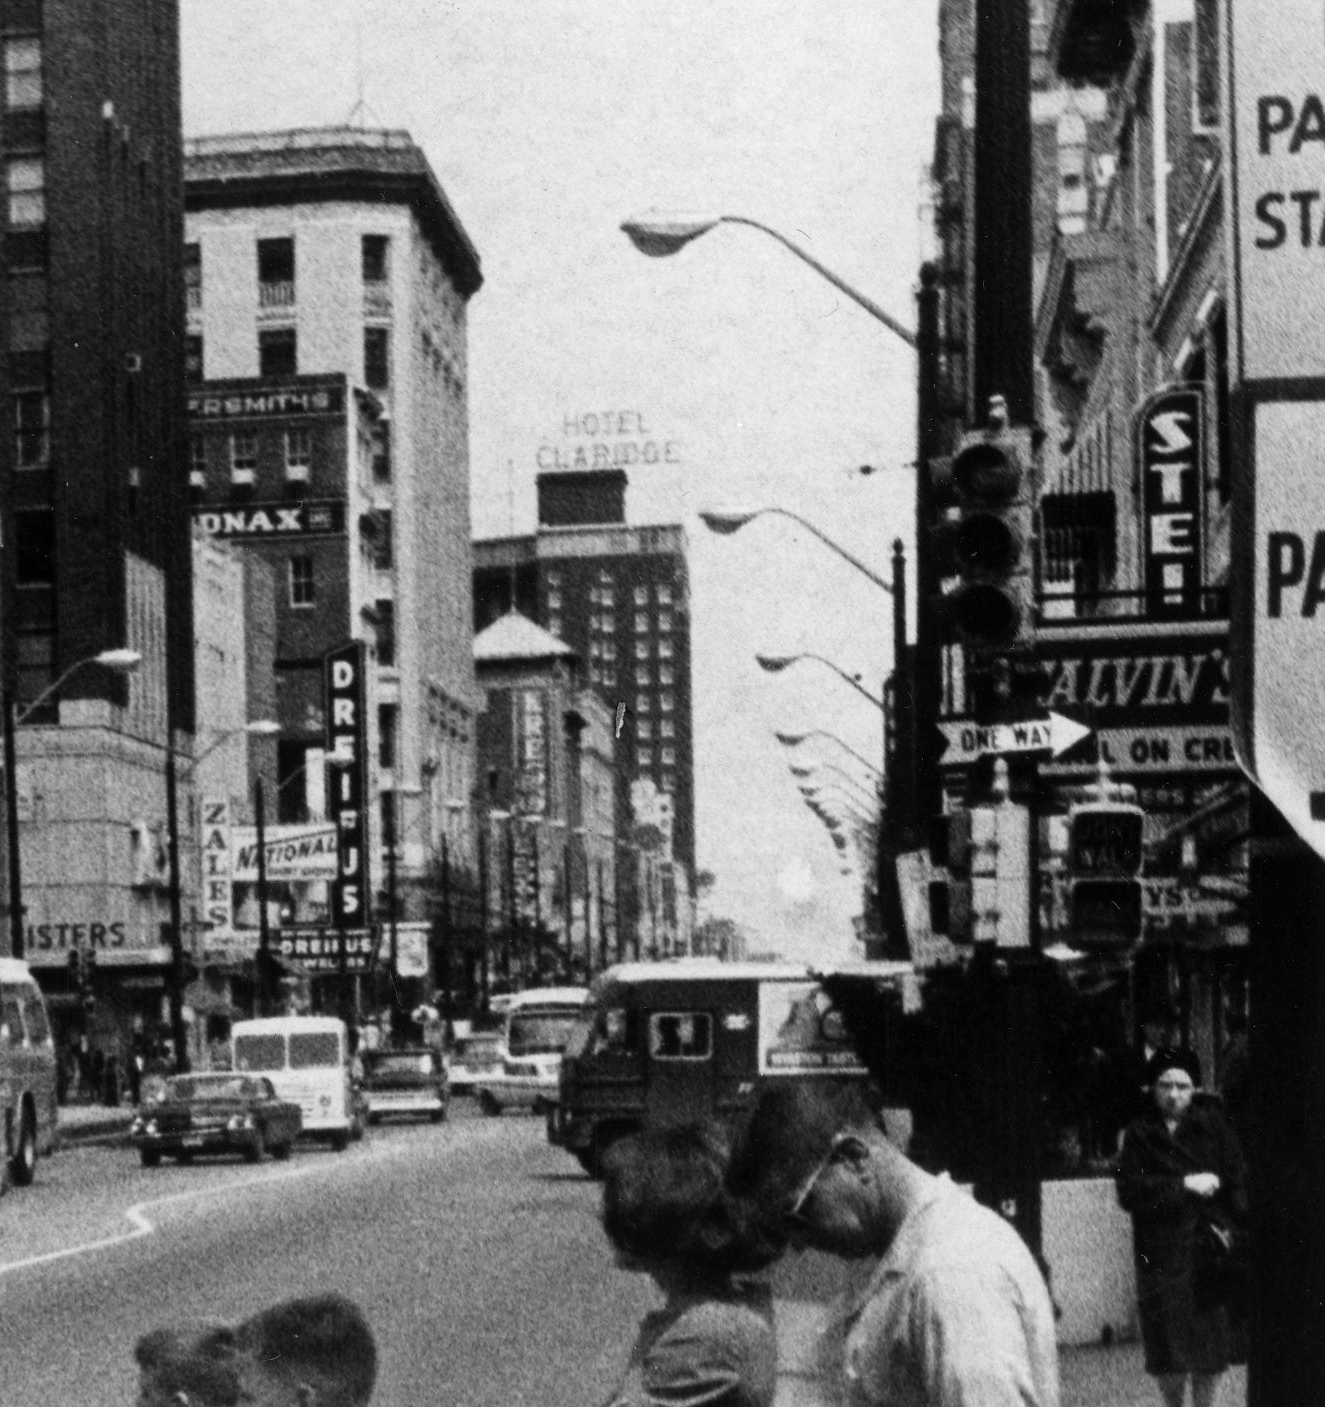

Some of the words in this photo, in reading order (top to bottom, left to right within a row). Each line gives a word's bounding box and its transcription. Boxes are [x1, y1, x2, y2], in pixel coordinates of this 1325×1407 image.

[1254, 190, 1325, 251] ST
[563, 409, 650, 437] HOTEL
[536, 440, 680, 470] CLARIDGE
[961, 727, 999, 752] ONE
[1130, 738, 1169, 763] ON
[205, 802, 229, 928] ZALES
[26, 921, 127, 950] ISTERS
